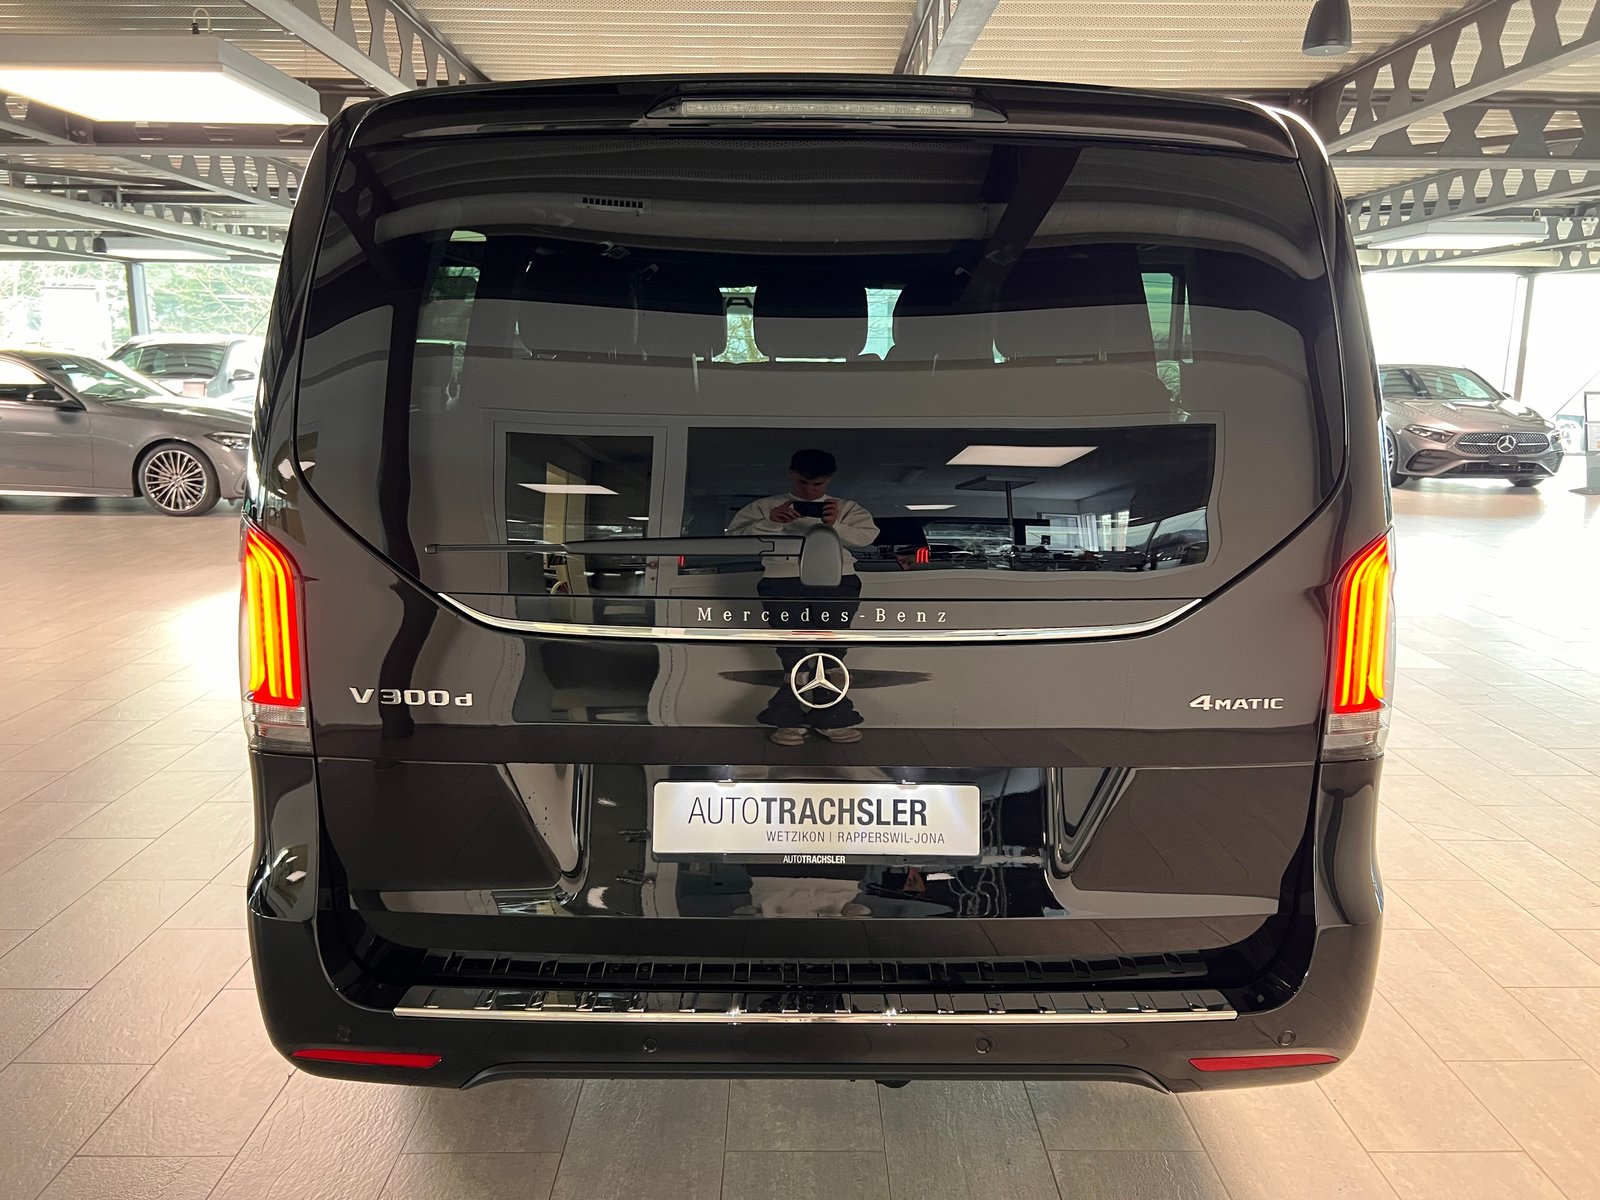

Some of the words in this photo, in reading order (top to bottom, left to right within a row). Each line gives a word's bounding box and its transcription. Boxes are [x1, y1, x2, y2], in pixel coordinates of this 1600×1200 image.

[697, 607, 947, 623] Mercedes-Benz
[1189, 694, 1284, 711] 4MATIC
[687, 796, 928, 826] AUTOTRACHSLER
[766, 831, 825, 843] WETZIKON
[837, 831, 945, 844] RAPPERSWIL-JONA
[782, 854, 846, 864] AUTOTRACHSLER
